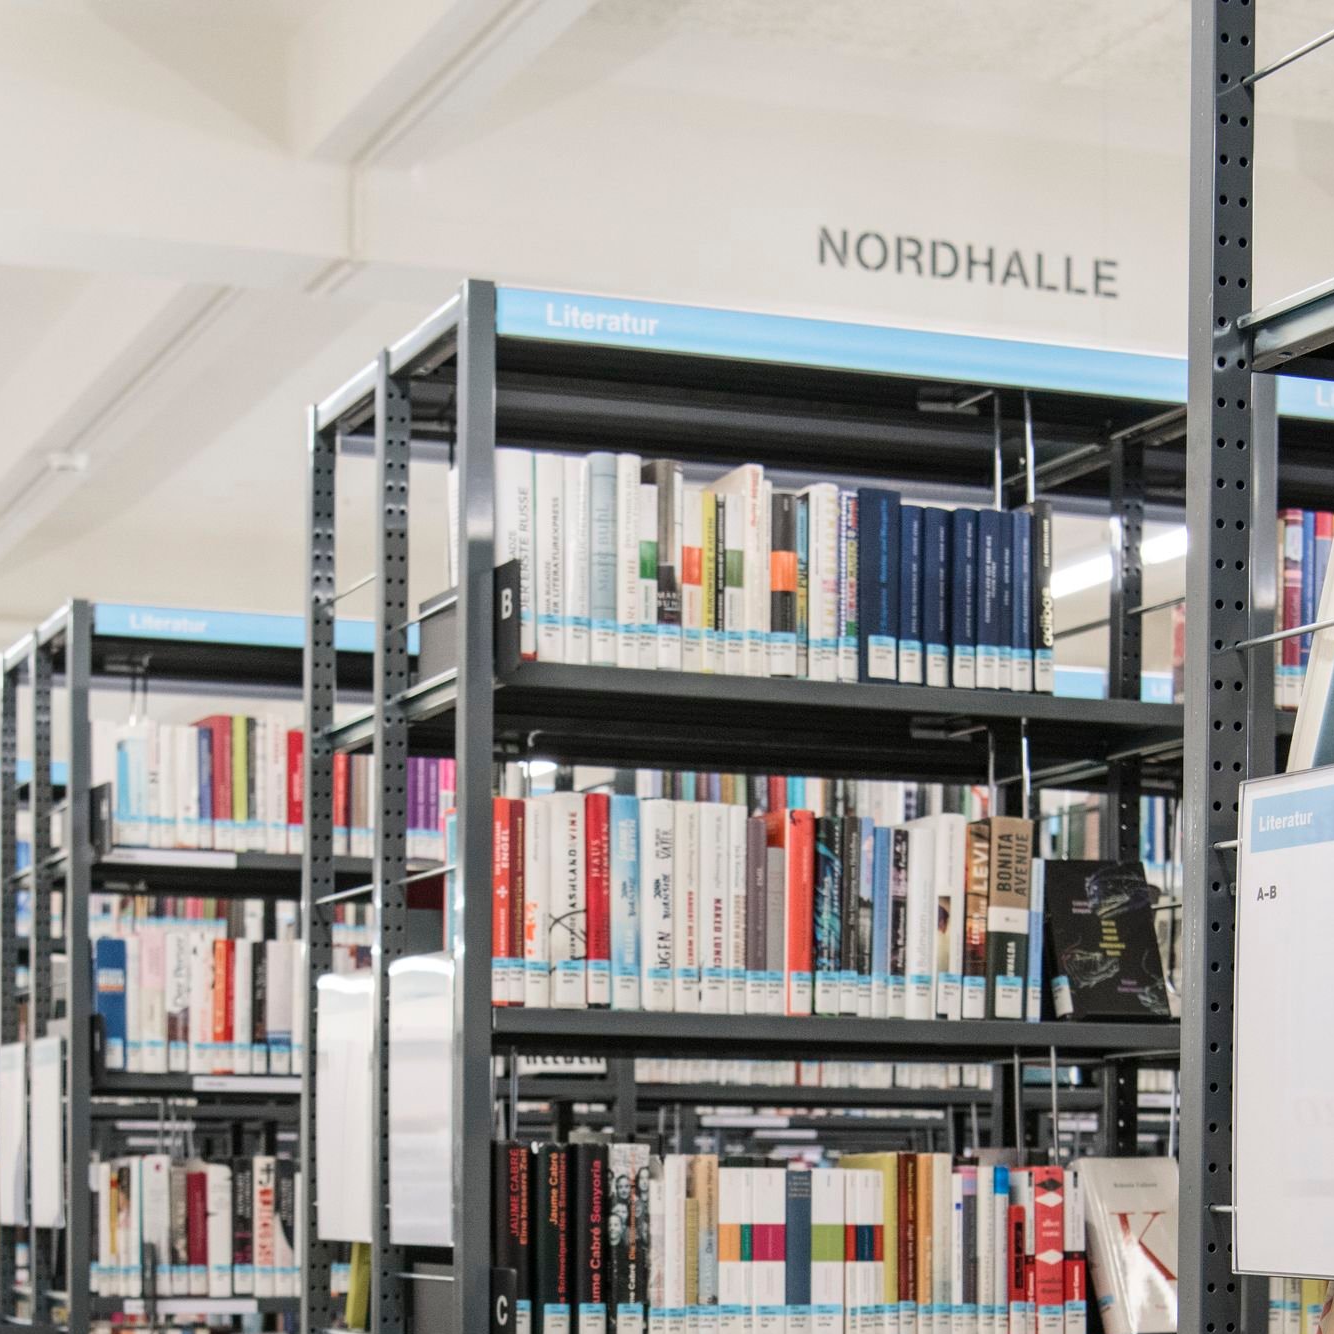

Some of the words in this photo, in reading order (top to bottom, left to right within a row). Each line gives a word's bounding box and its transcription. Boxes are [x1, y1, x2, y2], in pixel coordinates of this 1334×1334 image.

[816, 226, 1120, 299] NORDHALLE
[545, 303, 659, 337] Literatur
[519, 487, 529, 534] RUSSE
[520, 537, 529, 581] ERSTE
[129, 614, 207, 634] Literatur
[501, 588, 512, 620] B
[569, 811, 578, 840] VINE
[1259, 810, 1314, 832] Literatur
[591, 839, 600, 878] HAUS
[972, 841, 989, 892] LEVI
[996, 833, 1013, 893] BONITA
[1014, 832, 1028, 897] AVENUE
[568, 848, 577, 910] ASHLAND
[714, 898, 722, 935] NAKED
[510, 1148, 519, 1192] CABRÉ
[519, 1148, 528, 1171] Zeit
[549, 1152, 558, 1186] Cabré
[519, 1172, 528, 1218] bessere
[549, 1187, 558, 1226] Jaume
[591, 1159, 602, 1223] Senyoria
[510, 1195, 519, 1237] JAUME
[519, 1219, 528, 1246] Eine
[558, 1214, 566, 1232] des
[558, 1232, 566, 1293] Schweigen
[590, 1227, 601, 1270] Cabré
[1110, 1211, 1176, 1281] K
[628, 1263, 636, 1290] Cabré
[496, 1295, 508, 1326] C
